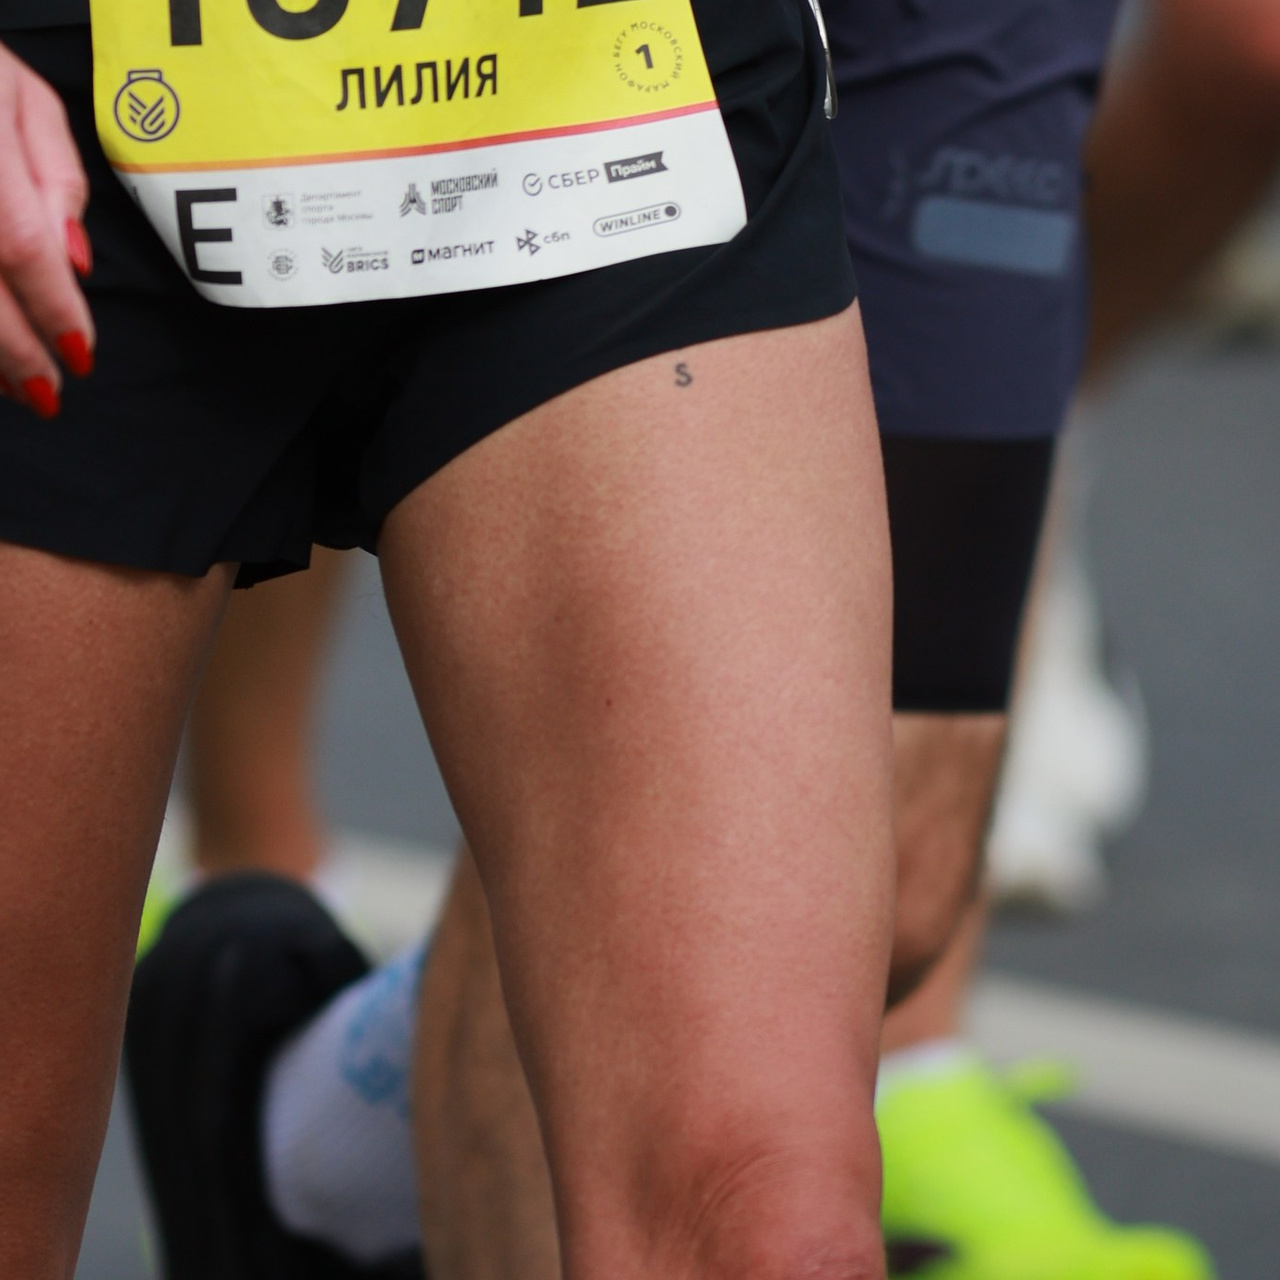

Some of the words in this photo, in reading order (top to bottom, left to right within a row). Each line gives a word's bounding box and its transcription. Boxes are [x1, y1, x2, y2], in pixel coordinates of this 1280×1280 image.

[635, 43, 654, 70] 1
[335, 53, 498, 111] ЛИЛИЯ
[431, 168, 498, 195] МОСКОВСКИЙ
[548, 169, 599, 190] СБЕР
[432, 195, 463, 214] СПОРТ
[600, 209, 660, 233] WINLINE
[175, 188, 242, 285] E
[347, 258, 389, 272] BRICS
